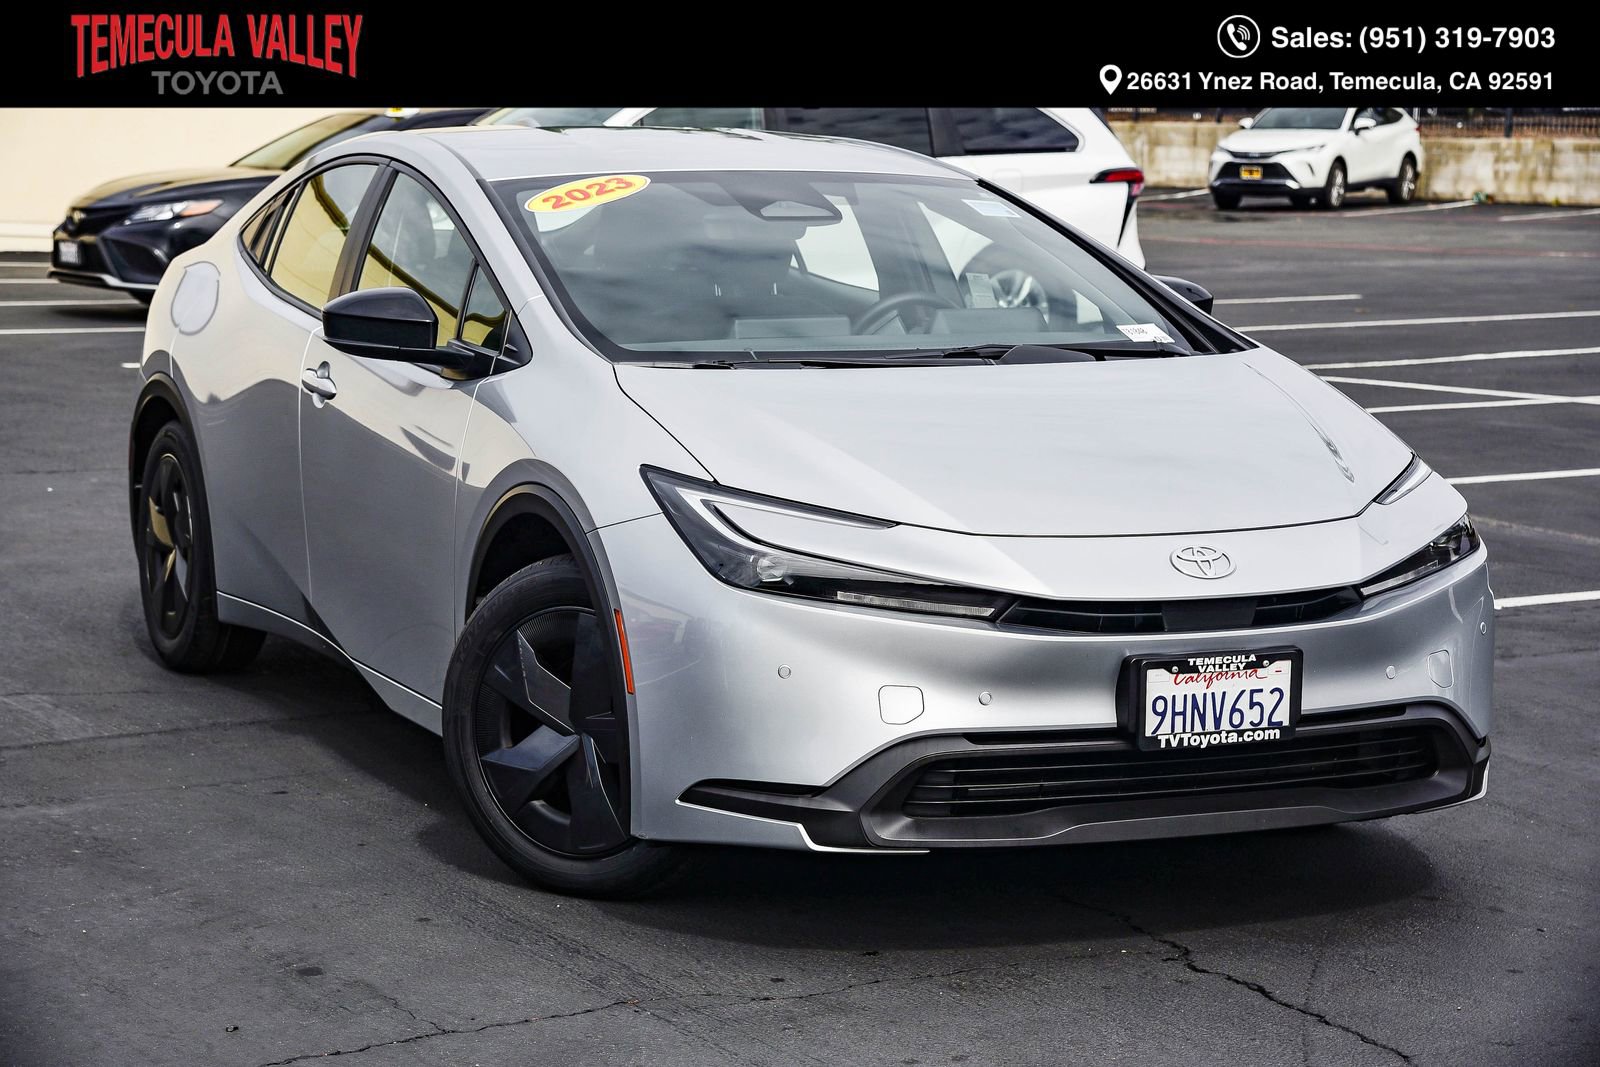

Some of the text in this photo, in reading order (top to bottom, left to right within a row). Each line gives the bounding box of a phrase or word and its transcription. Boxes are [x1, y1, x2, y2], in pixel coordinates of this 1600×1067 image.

[542, 177, 635, 210] 2023
[1188, 654, 1256, 666] TEMECULA
[1198, 663, 1246, 673] VALLEY
[1173, 668, 1267, 689] California
[1151, 687, 1284, 735] 9HNV652
[1157, 728, 1280, 748] TVToyota.com
